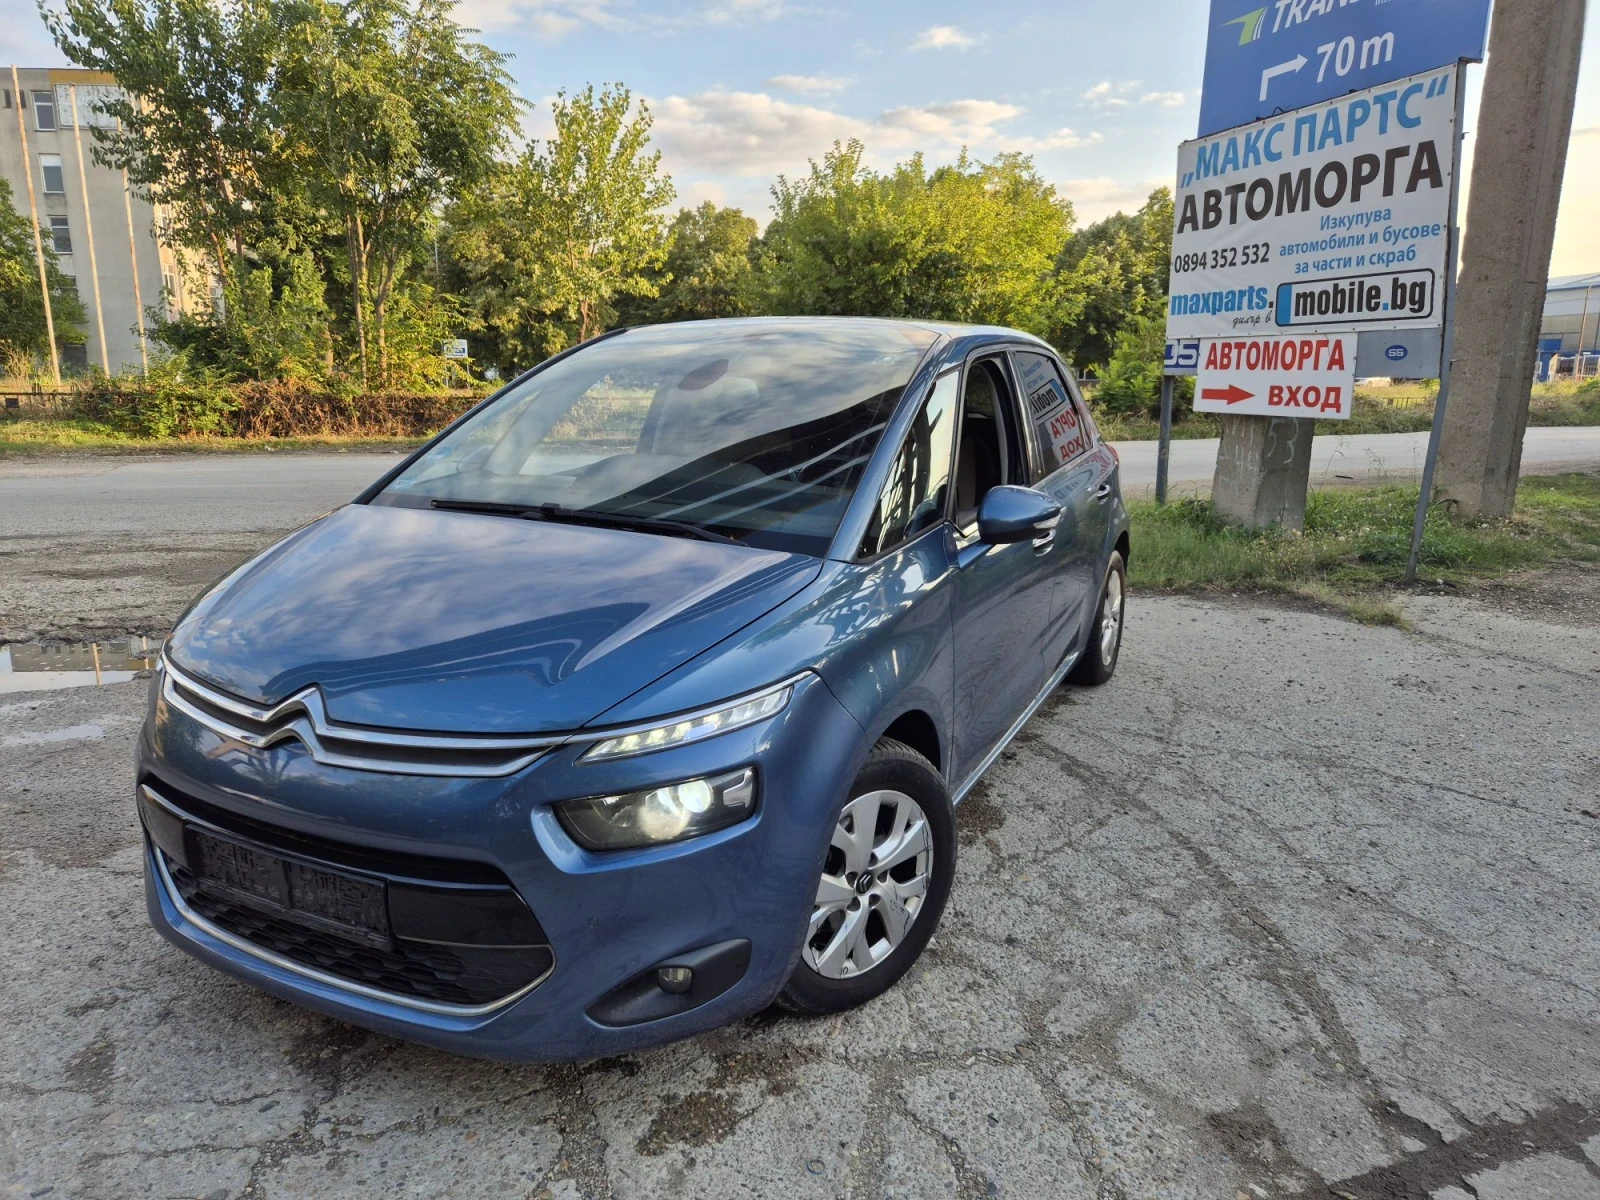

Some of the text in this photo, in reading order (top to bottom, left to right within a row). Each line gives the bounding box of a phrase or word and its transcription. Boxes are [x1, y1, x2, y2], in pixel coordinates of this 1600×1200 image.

[1316, 31, 1395, 84] 70 m
[1176, 139, 1444, 234] АВТОМОРГА
[1319, 208, 1392, 231] Изкупува
[1279, 223, 1441, 257] автомобили и бусове
[1173, 242, 1271, 274] 0894 352 532
[1294, 244, 1416, 274] за части и скраб
[1294, 277, 1427, 318] mobile.bg
[1204, 339, 1345, 371] АВТОМОРГА
[1267, 385, 1342, 414] ВХОД
